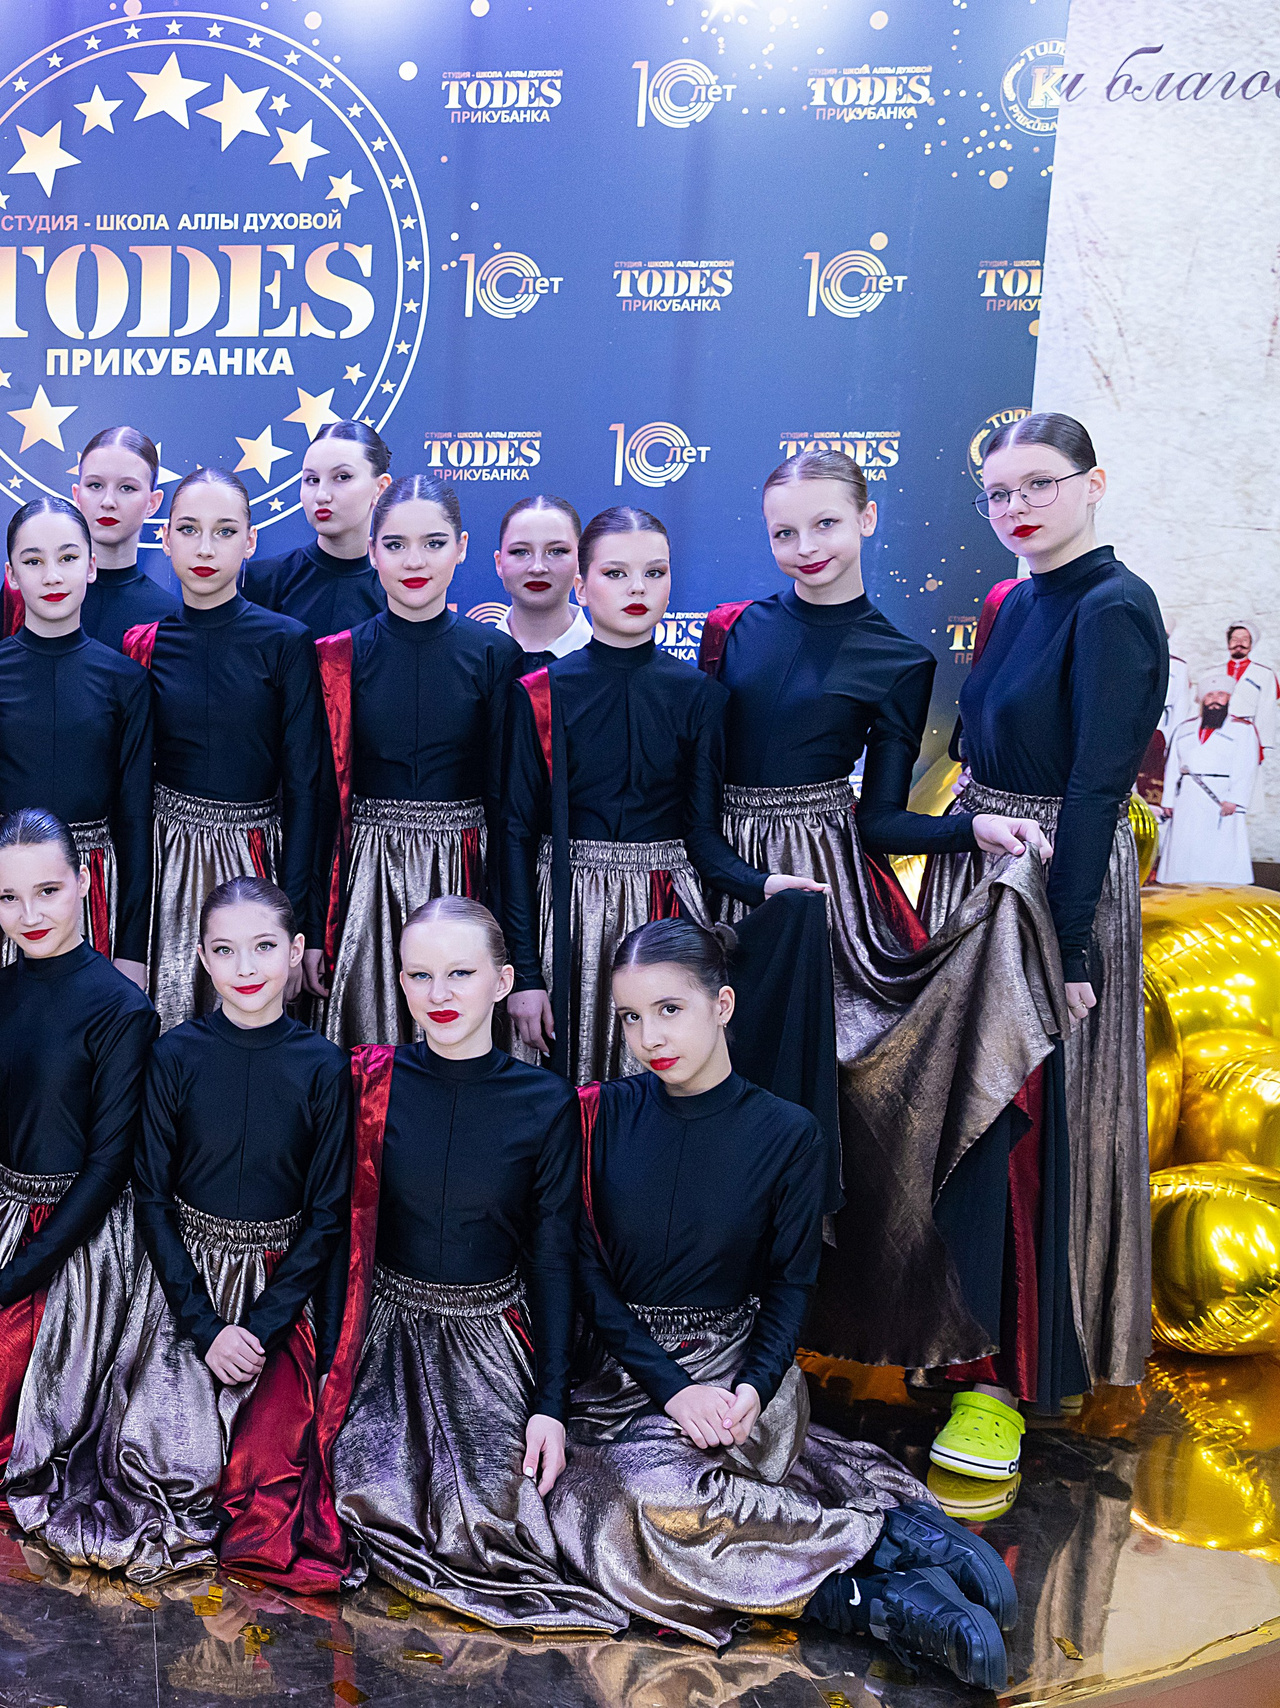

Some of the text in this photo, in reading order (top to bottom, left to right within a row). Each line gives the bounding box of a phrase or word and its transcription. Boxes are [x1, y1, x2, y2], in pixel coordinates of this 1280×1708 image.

[441, 79, 562, 109] TODES
[631, 58, 737, 128] 10 лет
[807, 75, 931, 106] TODES
[451, 110, 550, 123] ПРИКУБАНКА
[816, 106, 918, 120] ПРИКУБАНКА
[1008, 104, 1058, 131] PRIKUBA
[1, 215, 78, 233] СТУДИЯ
[96, 213, 169, 231] ШКОЛА
[177, 212, 240, 231] АЛЛЫ
[243, 209, 342, 233] ДУХОВОЙ
[459, 251, 564, 319] 10 лет
[613, 269, 733, 297] TODES
[803, 250, 908, 318] 10 лет
[977, 268, 1043, 297] TO
[622, 299, 721, 311] ПРИКУБАНКА
[986, 299, 1041, 311] ПРИКУ
[46, 347, 294, 376] ПРИКУБАНКА
[423, 440, 541, 467] TODES
[608, 421, 711, 487] 10 лет
[433, 468, 530, 481] ПРИКУБАНКА
